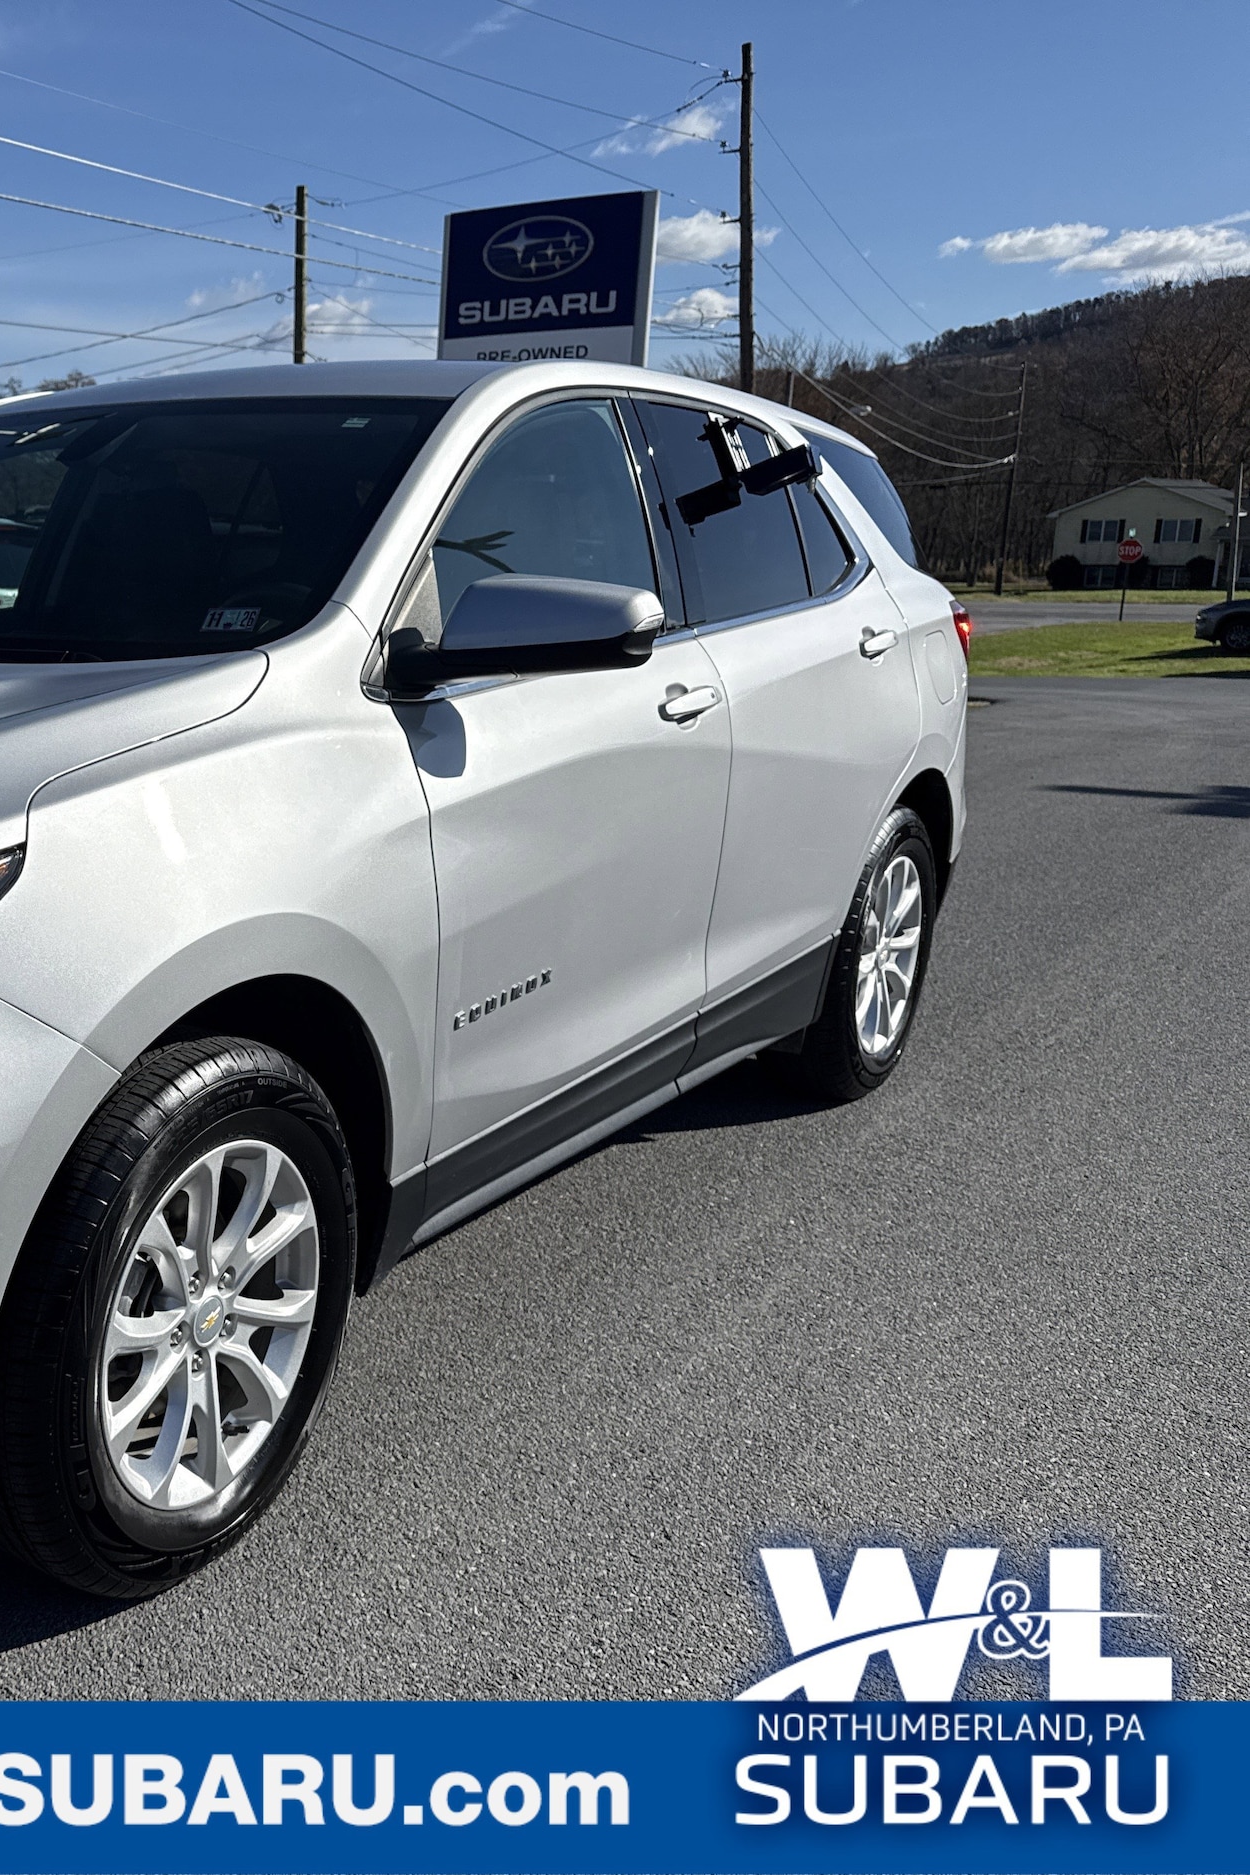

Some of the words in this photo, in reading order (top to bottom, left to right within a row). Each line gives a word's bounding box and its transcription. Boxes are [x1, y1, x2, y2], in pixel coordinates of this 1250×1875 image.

[458, 290, 617, 325] SUBARU
[477, 345, 588, 362] PRE-OWNED
[1119, 545, 1141, 556] STOP
[240, 610, 257, 627] 26
[453, 967, 552, 1031] EQUINOX
[257, 1077, 288, 1089] OUTSIDE
